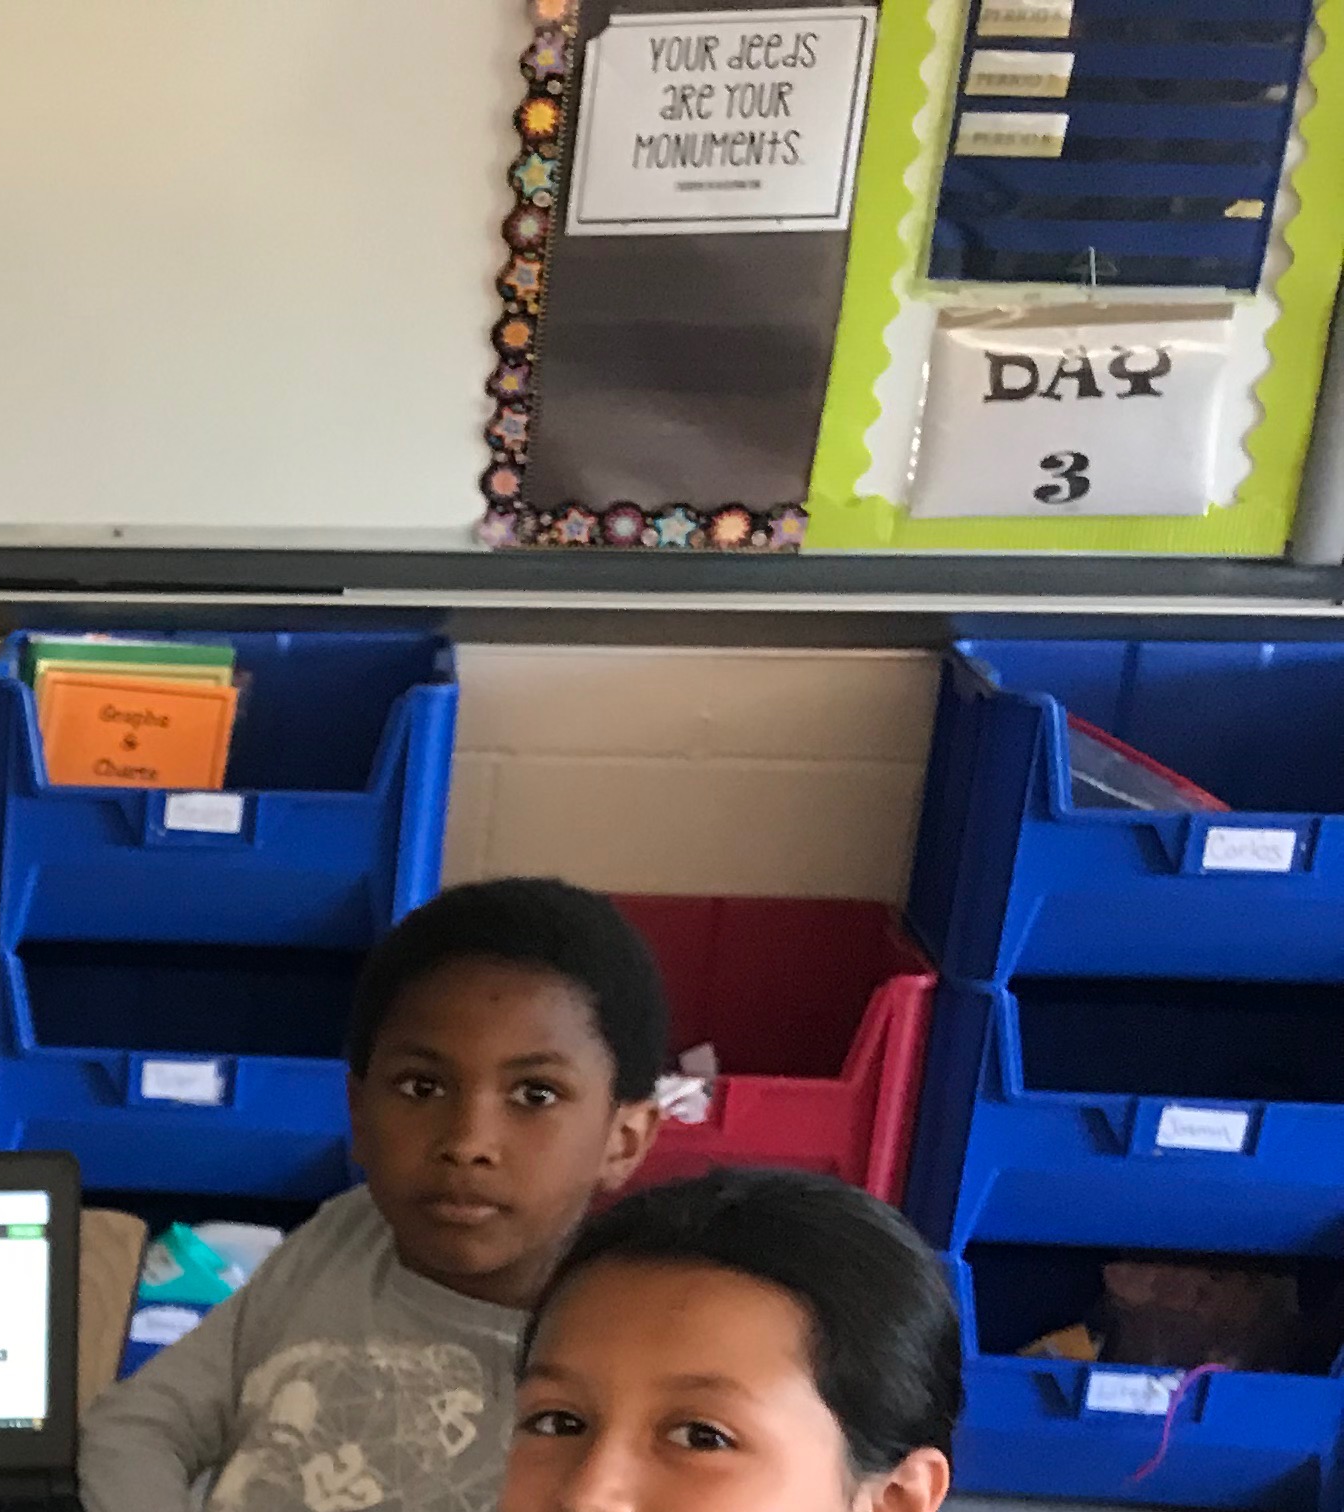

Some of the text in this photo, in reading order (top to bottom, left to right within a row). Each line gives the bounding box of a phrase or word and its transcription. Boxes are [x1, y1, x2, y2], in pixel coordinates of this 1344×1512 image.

[649, 34, 720, 73] YOUR
[724, 81, 794, 119] YOUR
[981, 344, 1172, 403] DAY
[1032, 450, 1091, 504] 3
[98, 704, 171, 731] Graphs
[92, 757, 159, 781] Charts
